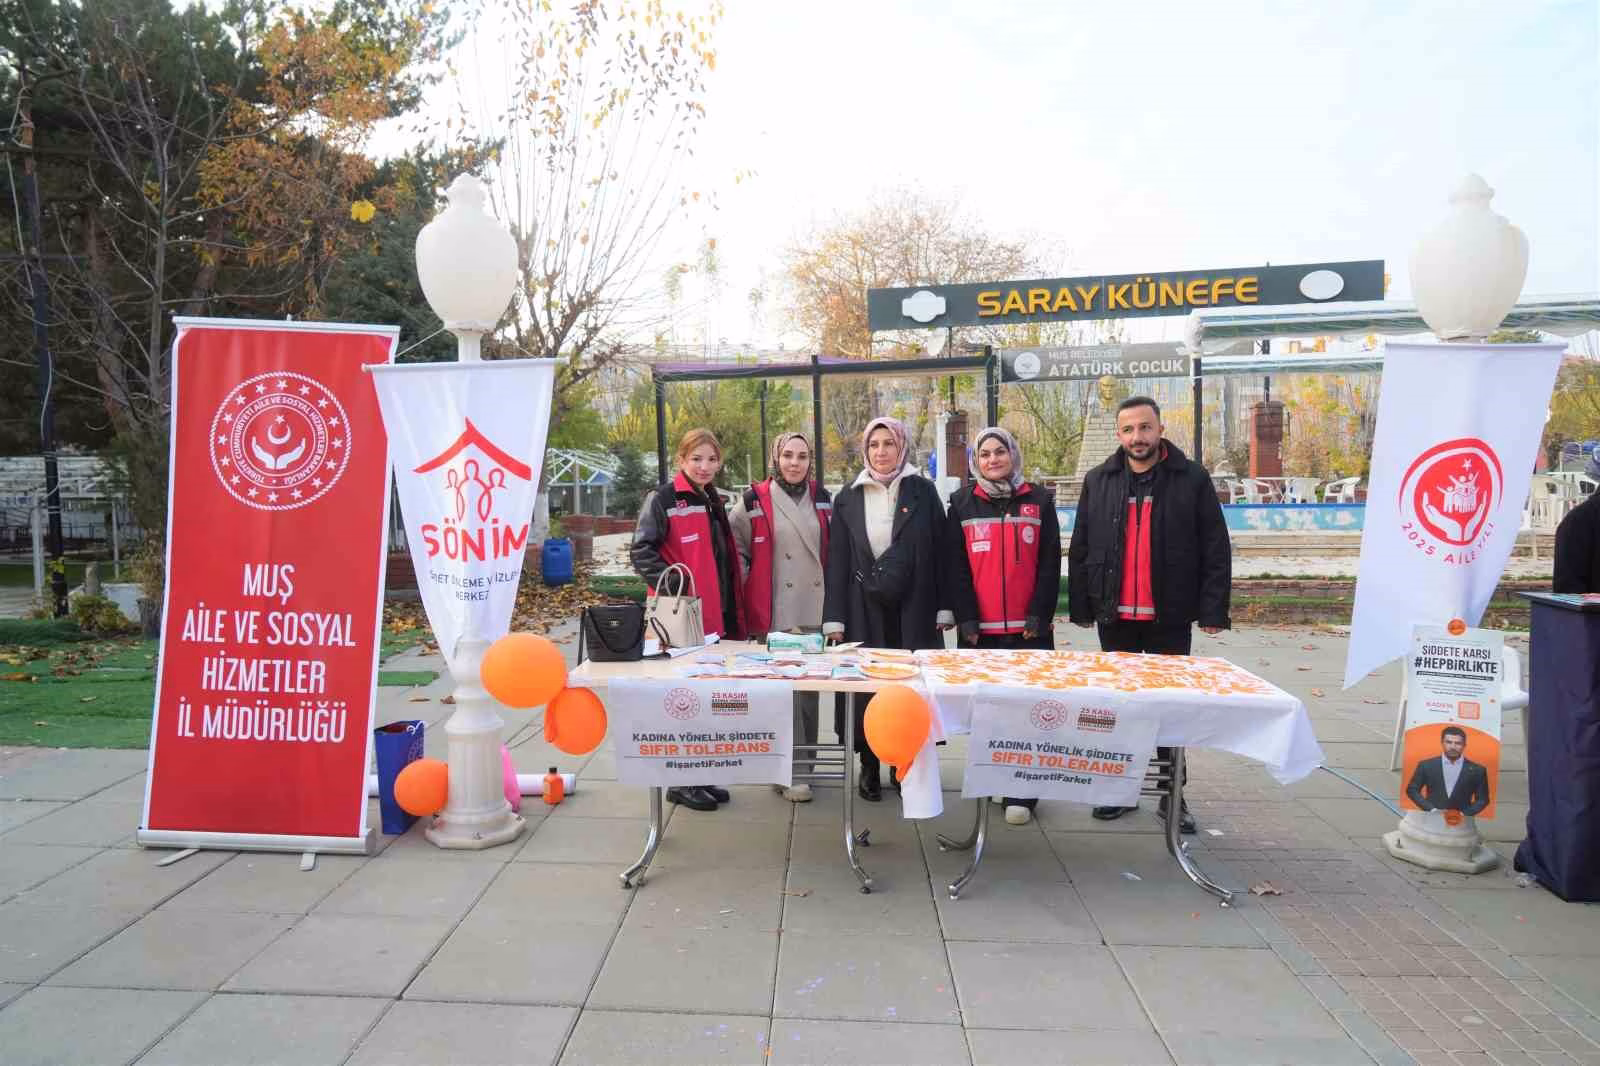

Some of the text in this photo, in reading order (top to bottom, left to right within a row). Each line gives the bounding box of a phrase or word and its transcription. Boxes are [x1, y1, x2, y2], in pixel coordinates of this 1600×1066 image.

[976, 276, 1259, 317] SARAY KÜNEFE
[1049, 359, 1184, 377] ATATÜRK ÇOCUK
[1402, 521, 1437, 556] 2025
[243, 563, 296, 606] MUŞ
[181, 602, 356, 647] AİLE VE SOSYAL
[201, 650, 326, 694] HİZMETLER
[1414, 656, 1498, 674] #HEPBİRLİKTE
[177, 696, 347, 743] İL MÜDÜRLÜĞÜ
[632, 730, 776, 743] KADINA YÖNELİK ŞİDDETE
[639, 742, 770, 755] SIFIR TOLERANS
[988, 739, 1032, 751] KADINA
[1036, 741, 1083, 756] YÖNELİK
[992, 751, 1125, 775] SIFIR TOLERANS
